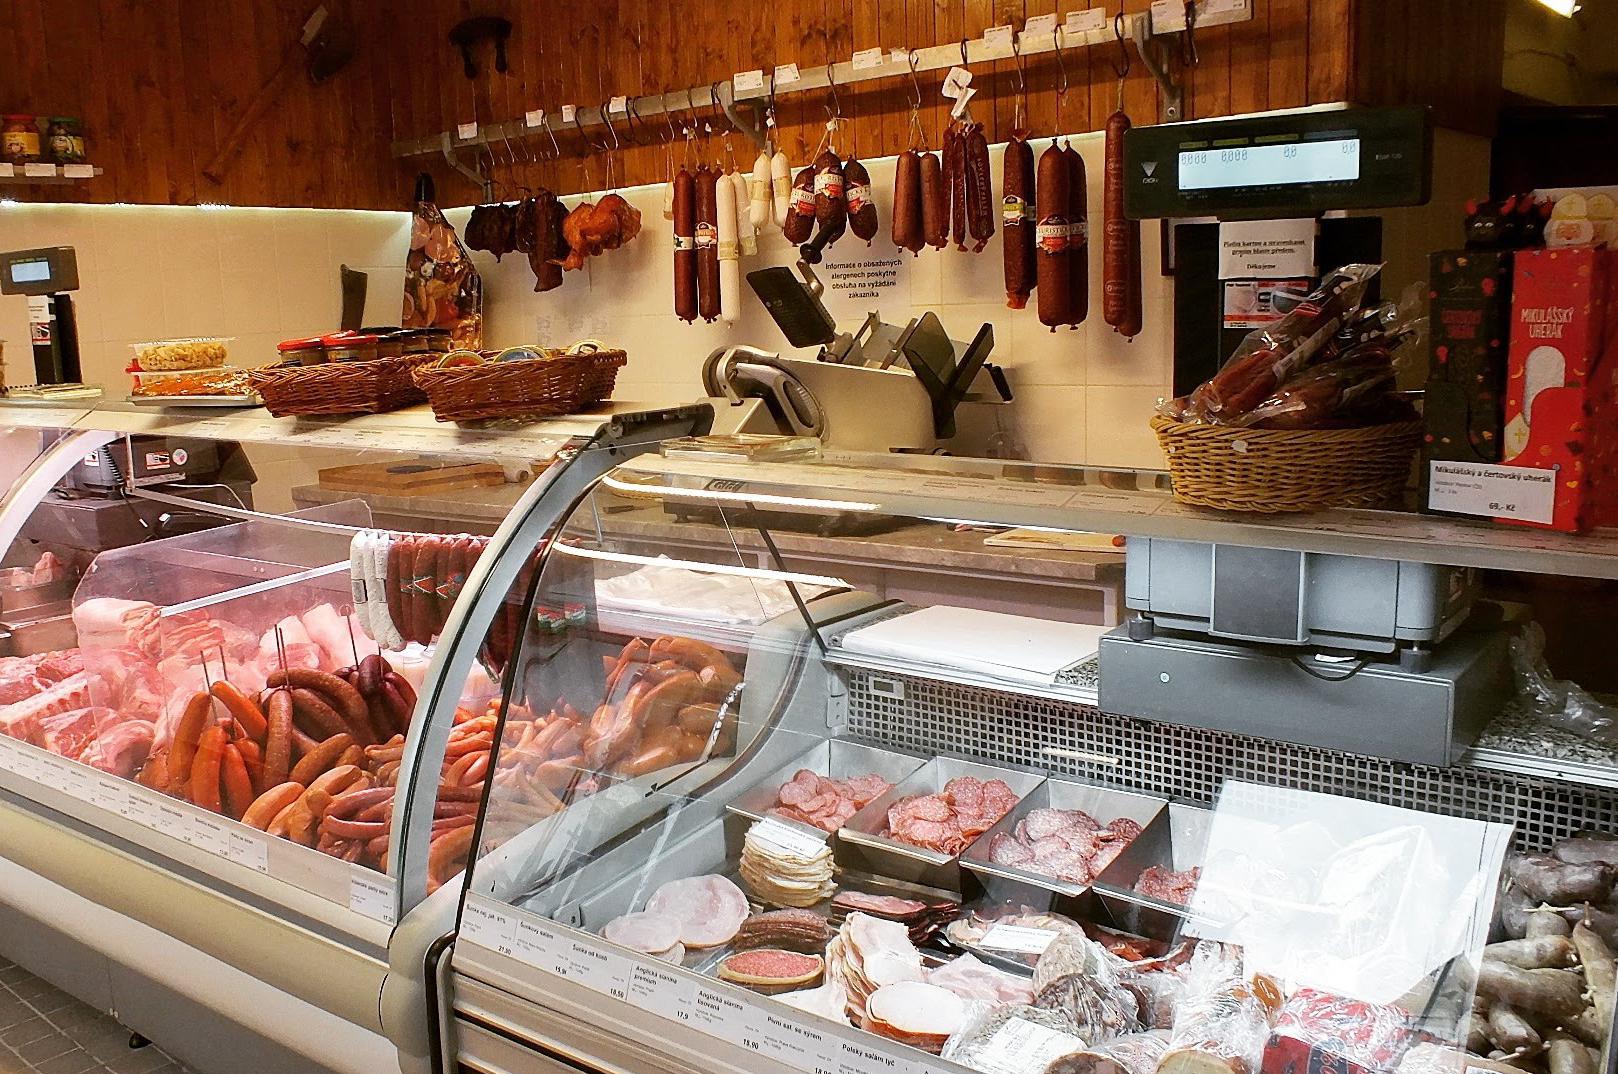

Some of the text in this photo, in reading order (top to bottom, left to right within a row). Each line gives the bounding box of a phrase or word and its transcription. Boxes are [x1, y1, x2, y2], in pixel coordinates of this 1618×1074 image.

[863, 259, 903, 268] obsažených
[831, 270, 897, 280] alergenech poskytne
[832, 281, 857, 290] obsluha
[1435, 465, 1476, 477] Mikulášský
[1484, 469, 1522, 481] čertovský
[1505, 503, 1516, 512] Kč
[635, 965, 658, 978] Anglická
[697, 998, 720, 1012] lisovaná
[698, 990, 743, 1011] Anglická slanina
[767, 1015, 782, 1027] Pivní
[794, 1026, 802, 1034] se
[803, 1030, 822, 1042] sýrem
[842, 1043, 895, 1067] Polský salám tyč
